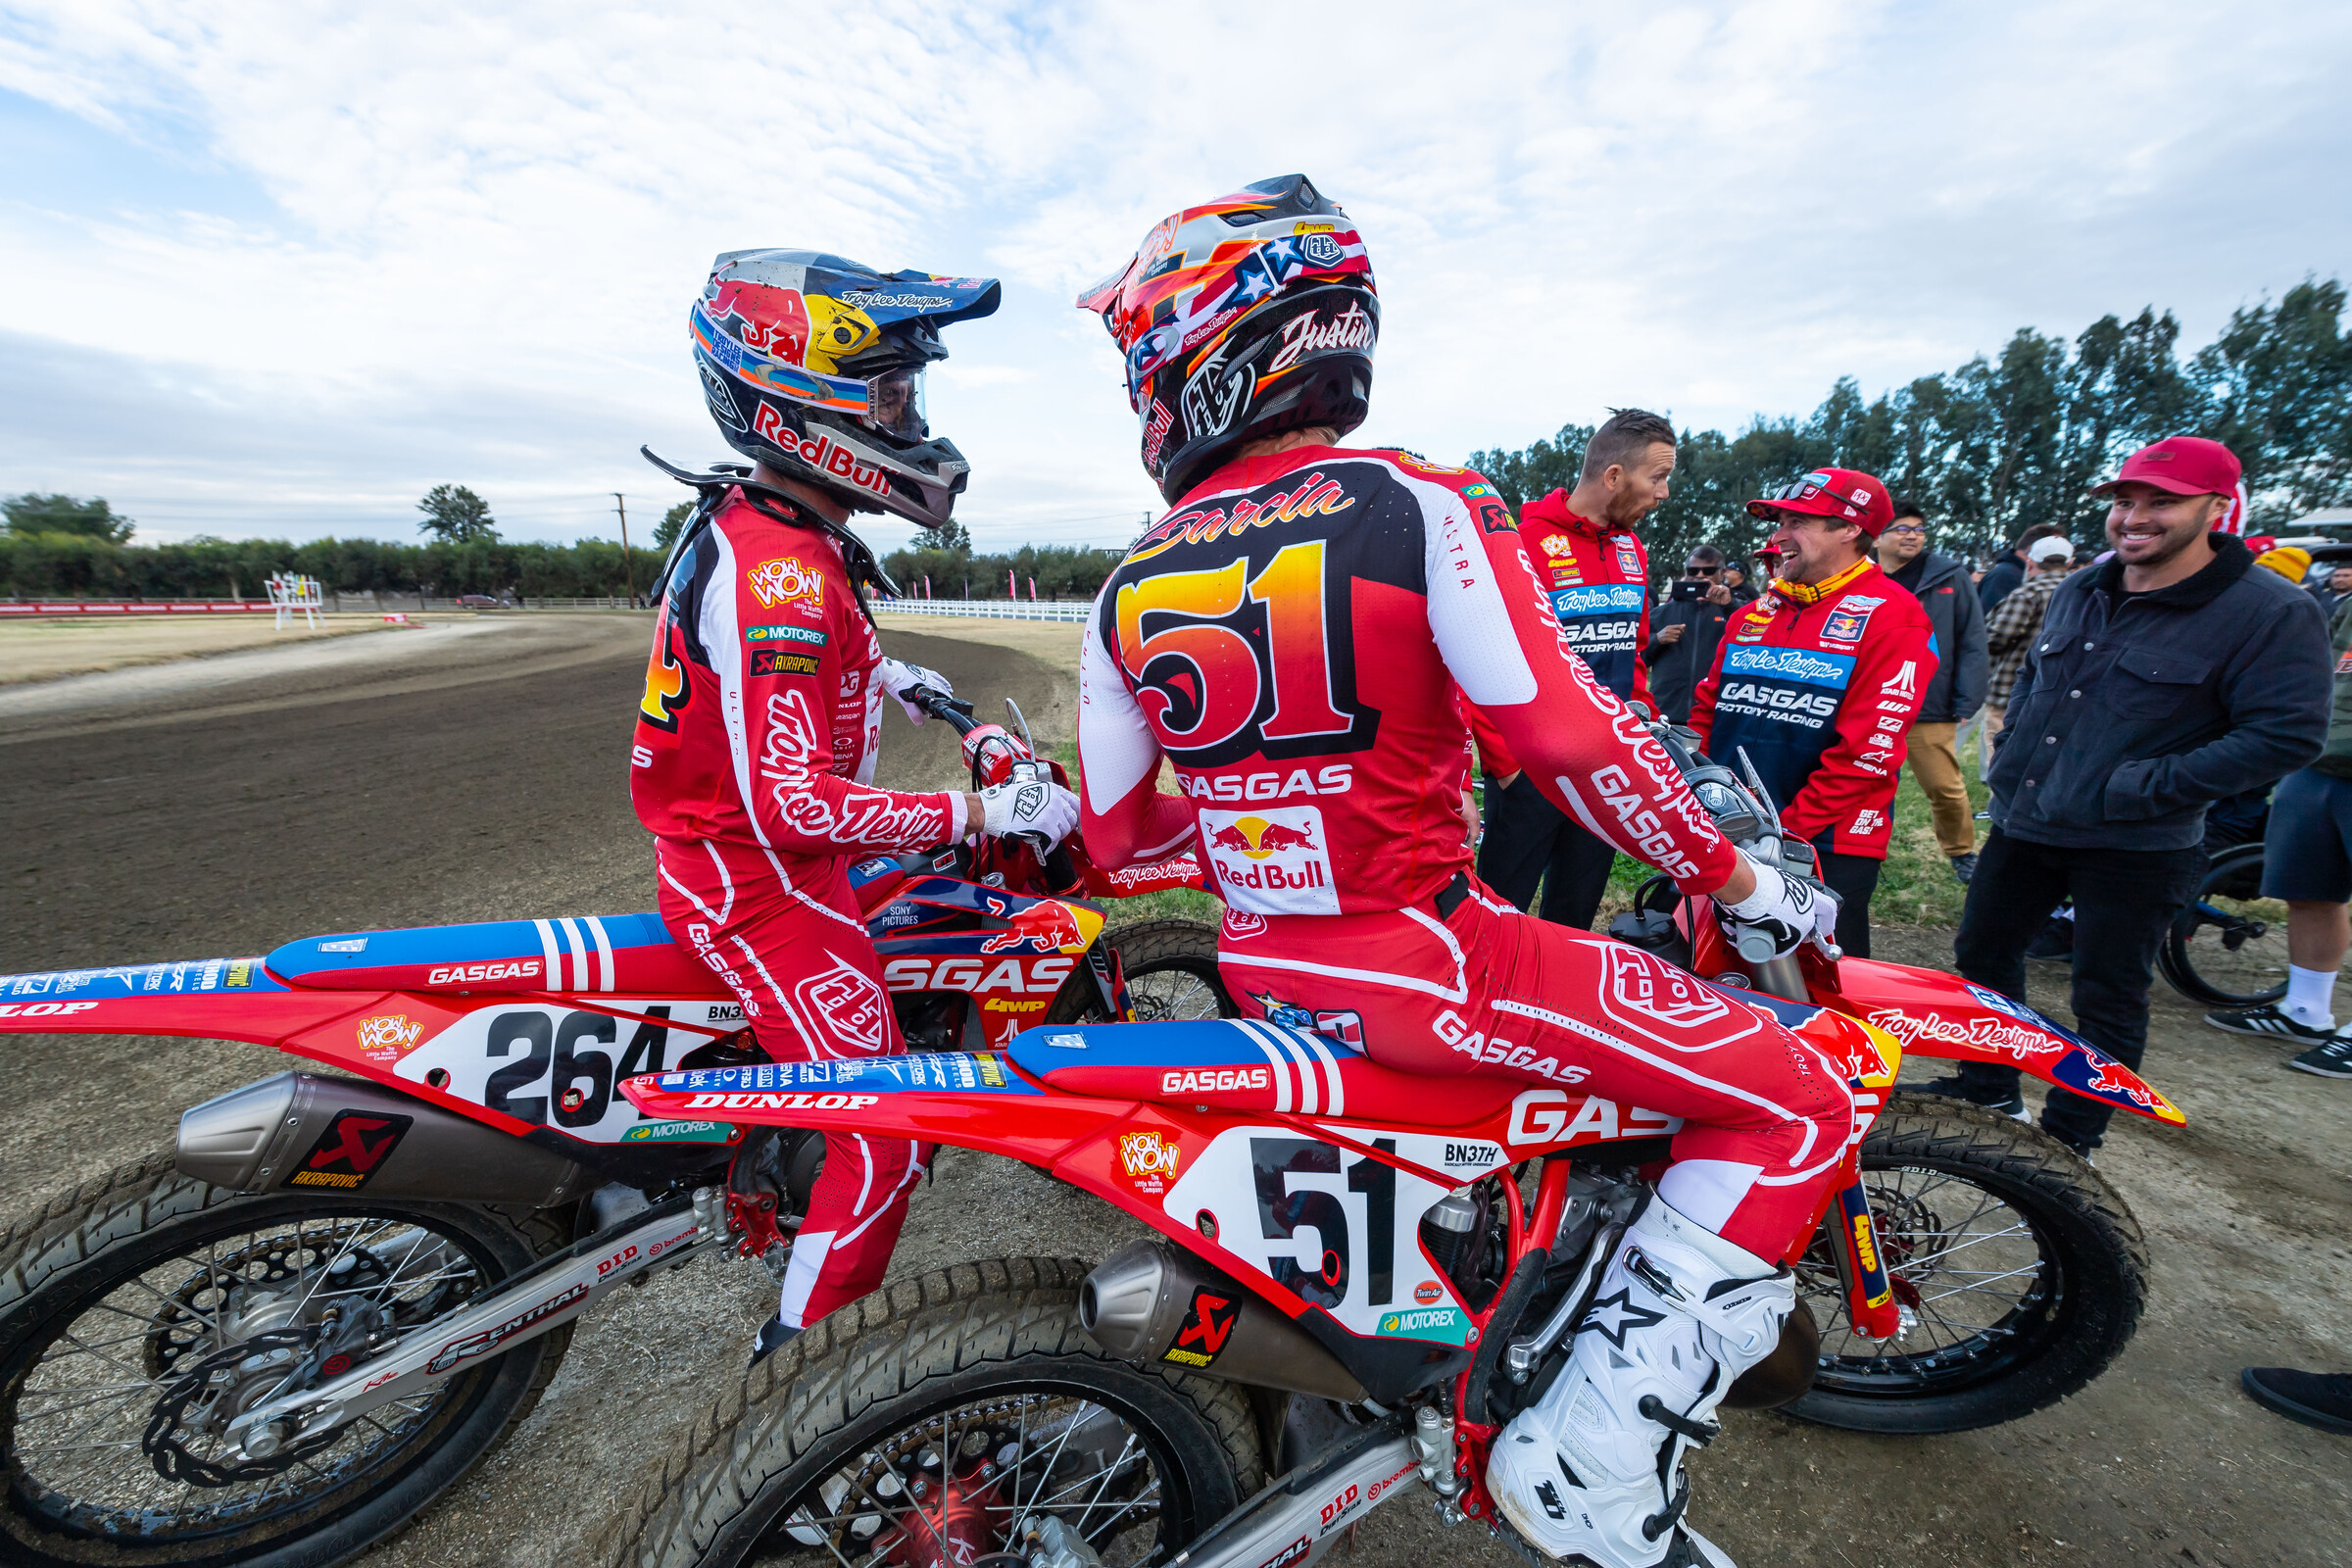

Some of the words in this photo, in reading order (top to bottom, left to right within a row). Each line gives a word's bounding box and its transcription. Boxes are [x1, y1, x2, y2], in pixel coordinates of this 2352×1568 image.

[842, 291, 872, 310] Troy
[870, 292, 897, 307] Lee
[896, 293, 954, 314] Designs
[1268, 298, 1374, 373] Justin
[1145, 397, 1175, 447] Bull
[753, 399, 831, 469] Red
[823, 445, 902, 498] Bull
[751, 559, 800, 586] WOW
[753, 568, 823, 606] WOW!
[1557, 590, 1588, 612] Troy
[1588, 589, 1610, 609] Lee
[768, 627, 825, 645] MOTOREX
[1563, 621, 1641, 643] GASGA
[1115, 539, 1355, 753] 51
[1568, 644, 1615, 655] CTORY
[1752, 650, 1779, 670] Le
[1777, 652, 1844, 680] Designs
[838, 700, 862, 710] NLOP
[1721, 682, 1838, 717] GASGAS
[1880, 688, 1900, 698] ATARI
[1766, 710, 1825, 730] RACNG
[760, 689, 817, 781] Troy
[1852, 760, 1887, 777] SENA
[1176, 763, 1354, 804] GASGAS
[1591, 764, 1700, 879] GASGAS
[1854, 817, 1873, 828] ON
[1858, 808, 1881, 820] GET
[1848, 825, 1874, 836] GAS!
[1109, 867, 1138, 890] Troy
[1136, 866, 1161, 881] Lee
[1159, 860, 1202, 883] Designs
[1215, 858, 1271, 892] Red
[1272, 860, 1325, 891] Bull
[882, 915, 919, 926] PICTURES
[890, 906, 912, 916] SONY
[201, 959, 223, 991] THOD
[427, 961, 540, 986] GASGAS
[687, 922, 762, 1018] GASGAS
[884, 956, 1074, 994] SGAS
[0, 1002, 99, 1018] LOP
[983, 997, 1047, 1013] 4WP
[359, 1023, 422, 1048] WOW!
[362, 1015, 404, 1034] WOW
[1867, 1008, 1923, 1048] Troy
[1918, 1012, 1970, 1044] Lee
[1969, 1017, 2065, 1060] Designs
[1431, 1009, 1592, 1085] GASGAS
[485, 1005, 672, 1128] 264
[951, 1052, 976, 1089] ETHOD
[1160, 1068, 1268, 1093] GASGAS
[683, 1094, 880, 1111] DUNLOP
[652, 1122, 716, 1139] MOTOREX
[1122, 1134, 1159, 1154] WOW
[1445, 1143, 1499, 1162] BN3TH
[1122, 1145, 1178, 1177] WOW!
[1250, 1137, 1397, 1310] 51
[662, 1226, 699, 1250] bremb
[1852, 1213, 1879, 1273] 4WP
[1413, 1289, 1430, 1299] Twin
[1429, 1287, 1443, 1298] Air
[1399, 1309, 1455, 1332] MOTOREX
[1382, 1459, 1422, 1490] brembo
